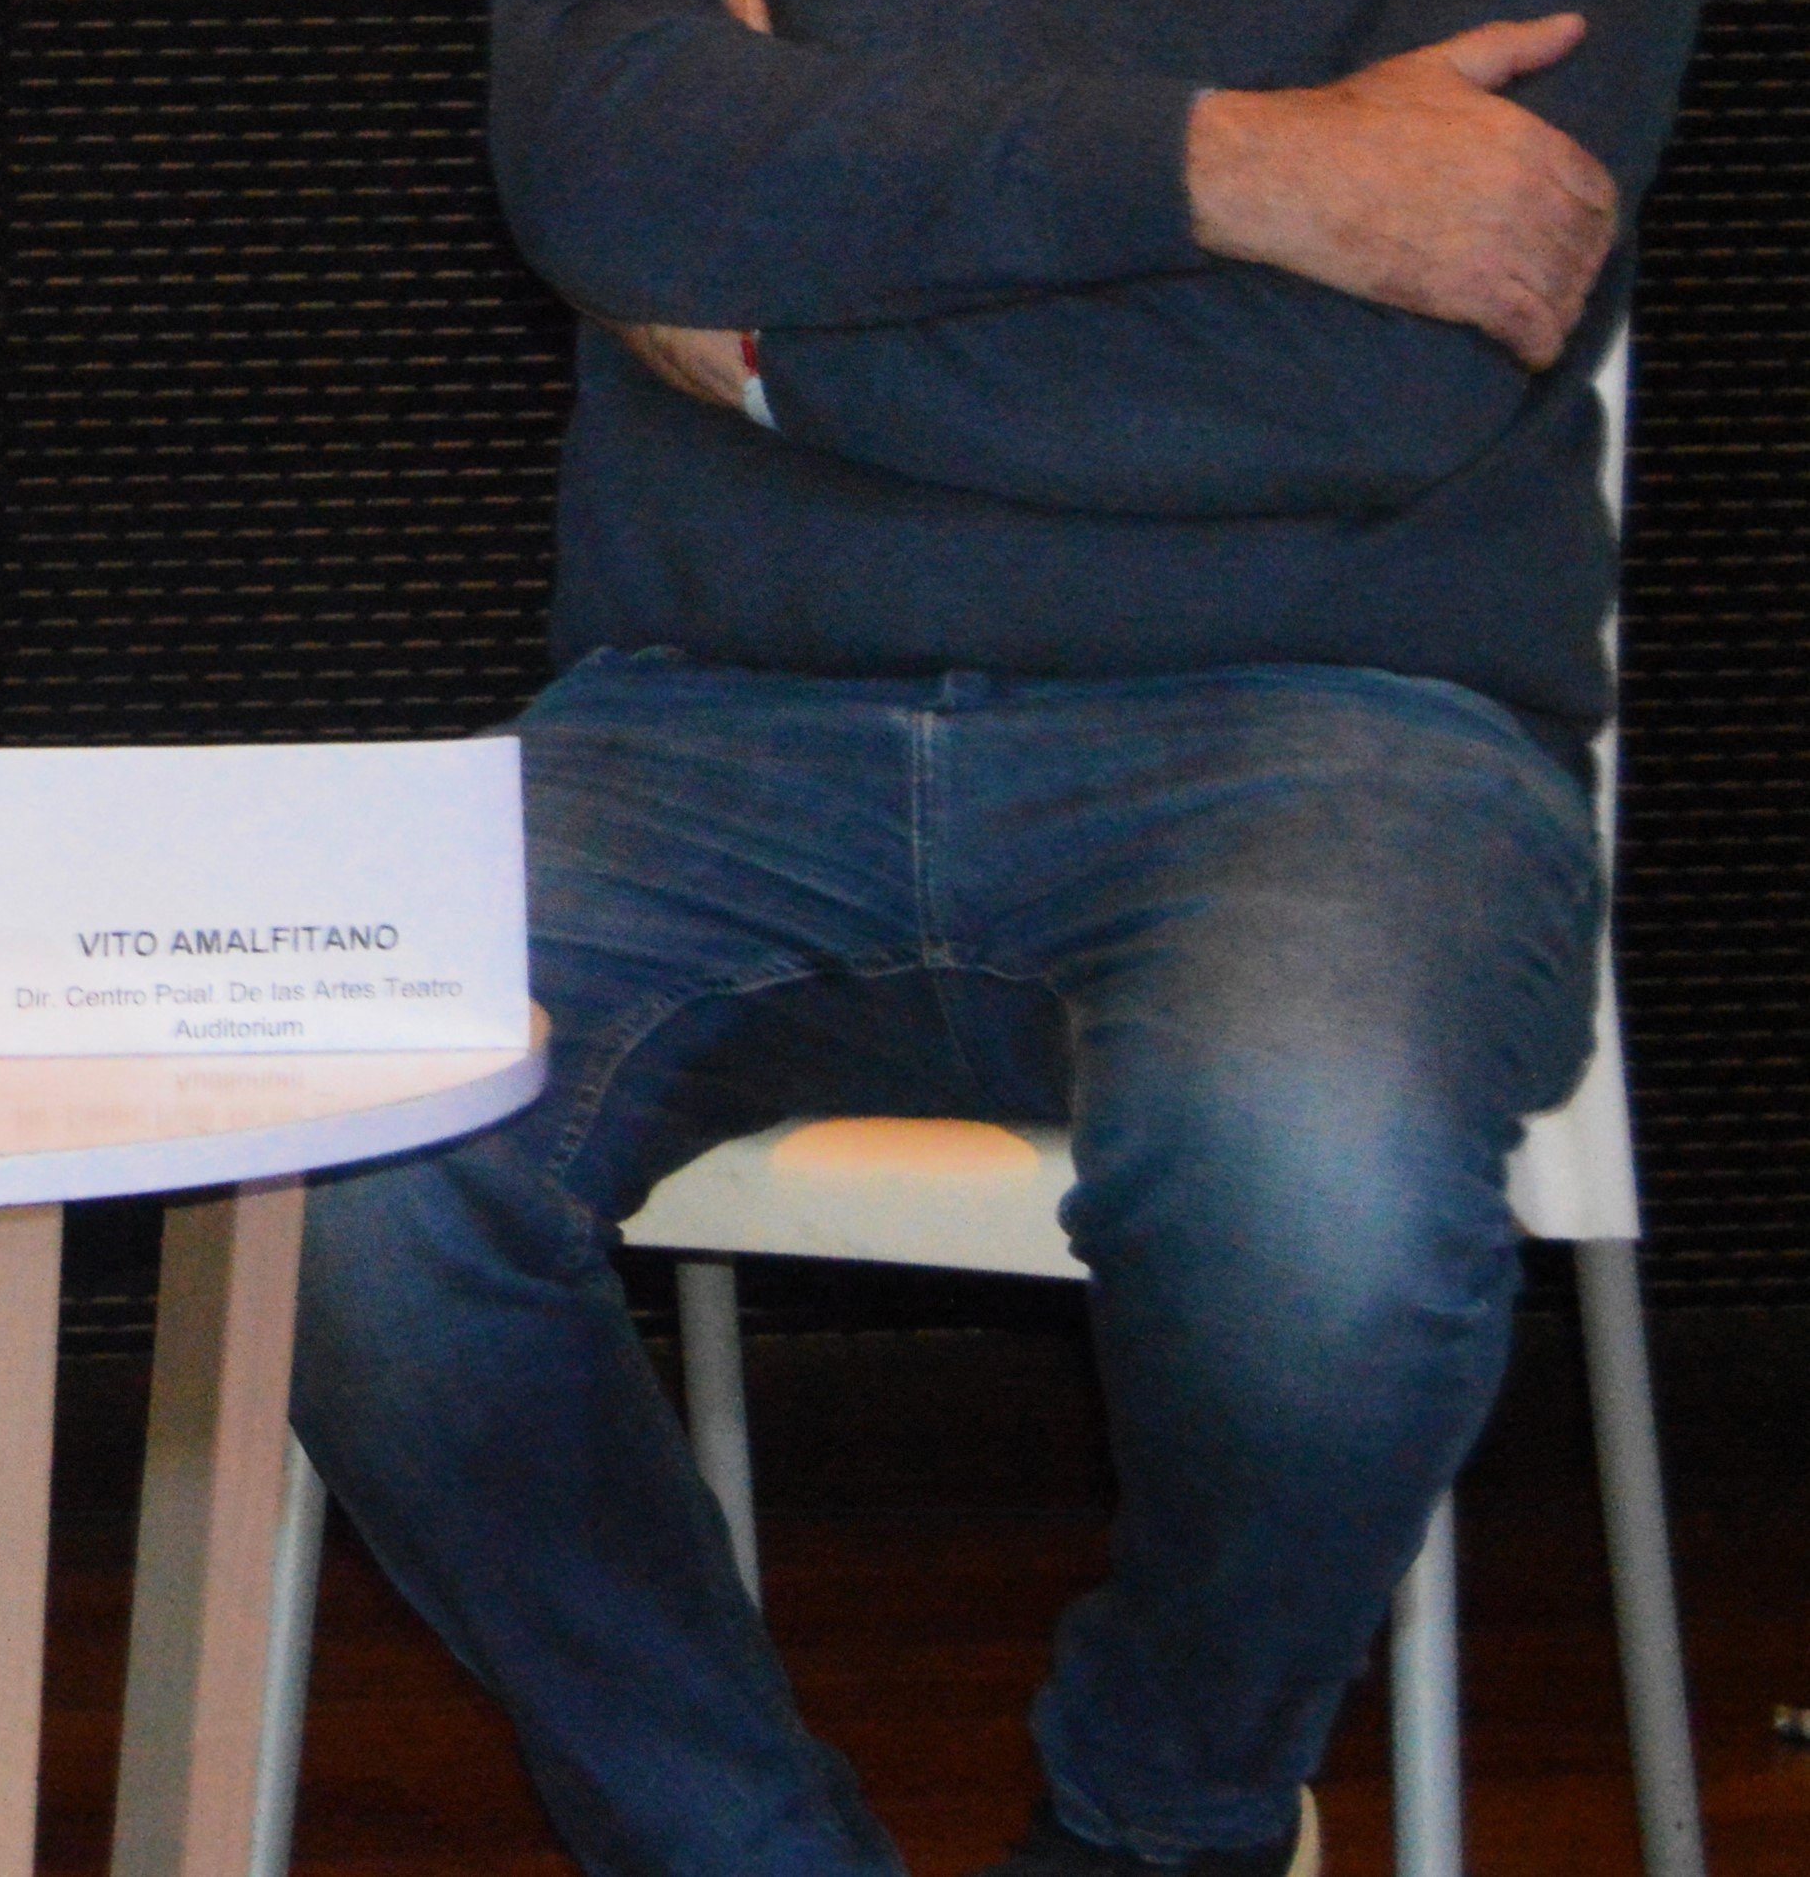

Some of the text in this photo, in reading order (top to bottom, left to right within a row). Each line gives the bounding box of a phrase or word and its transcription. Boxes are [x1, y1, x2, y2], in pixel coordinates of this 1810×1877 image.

[76, 922, 400, 959] VITO AMALFITANO
[15, 985, 55, 1009] Dir.
[65, 983, 147, 1009] Centro
[229, 980, 262, 1004] De
[271, 978, 305, 1002] las
[316, 977, 376, 1001] Artes
[383, 975, 463, 1000] Teatro
[173, 1015, 304, 1041] Auditorium
